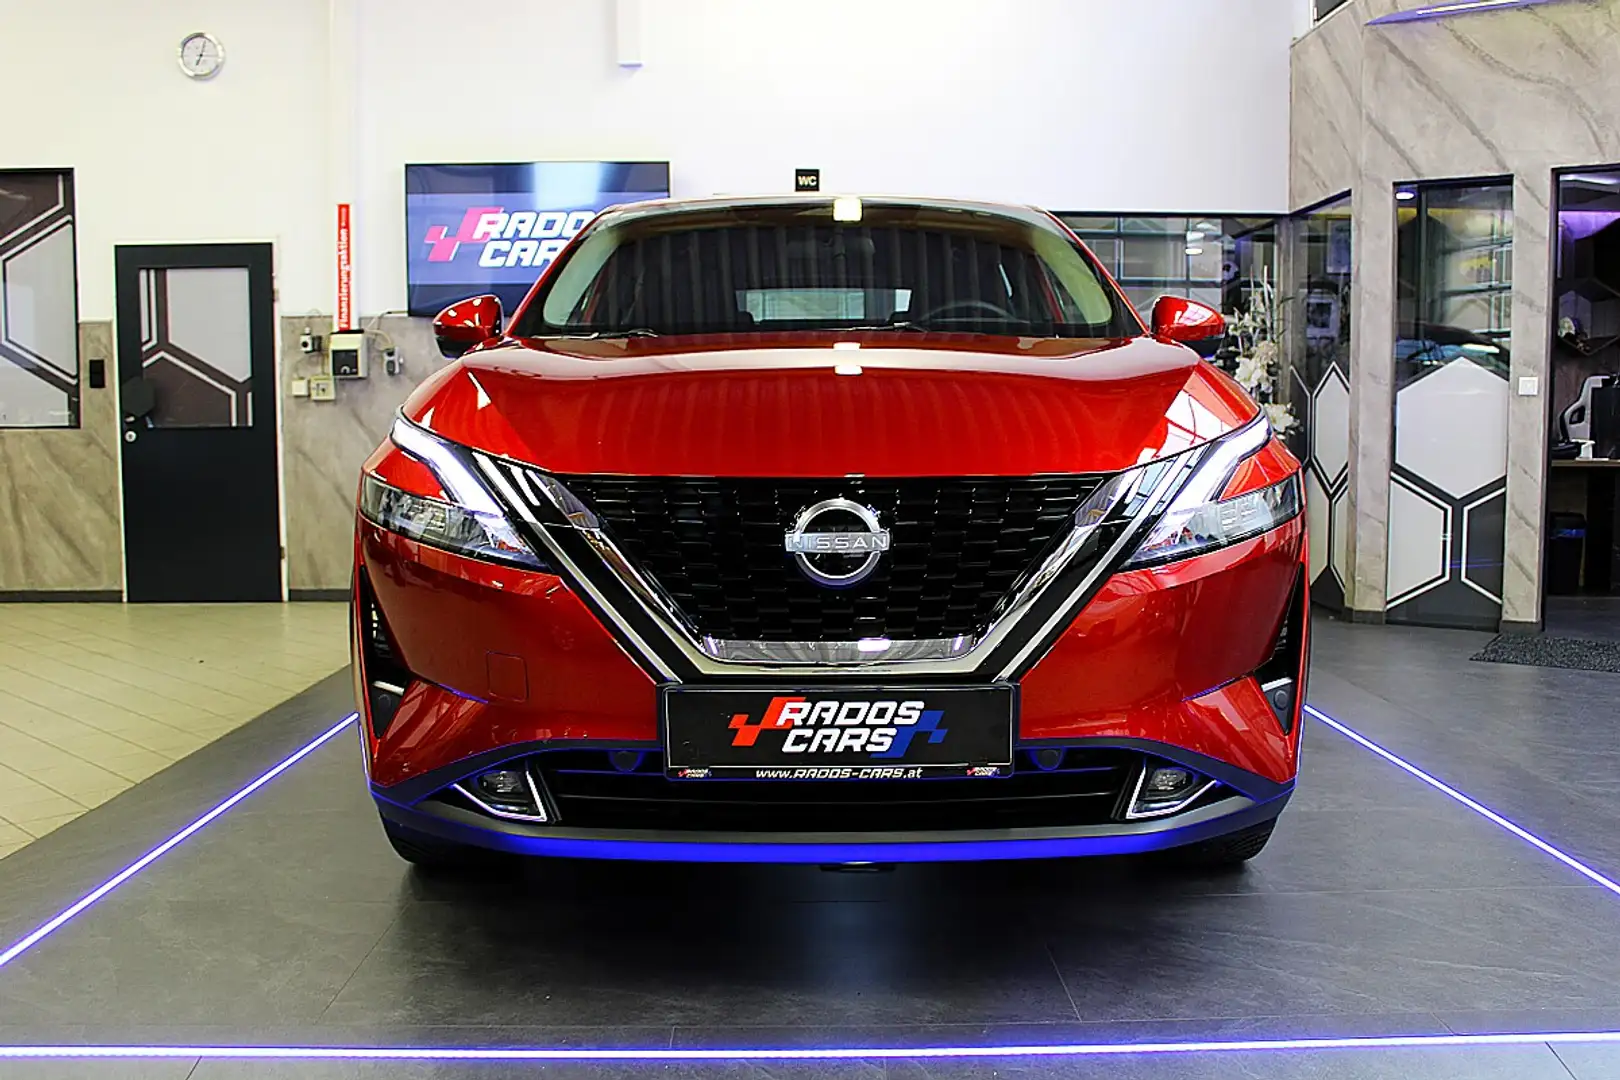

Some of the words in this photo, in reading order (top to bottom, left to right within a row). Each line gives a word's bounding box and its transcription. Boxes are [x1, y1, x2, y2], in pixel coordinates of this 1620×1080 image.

[797, 175, 817, 187] WC
[472, 211, 597, 240] RADO
[478, 239, 570, 268] CAR
[788, 536, 887, 549] NISSAN
[775, 700, 925, 726] RADOS
[781, 727, 898, 753] CARS
